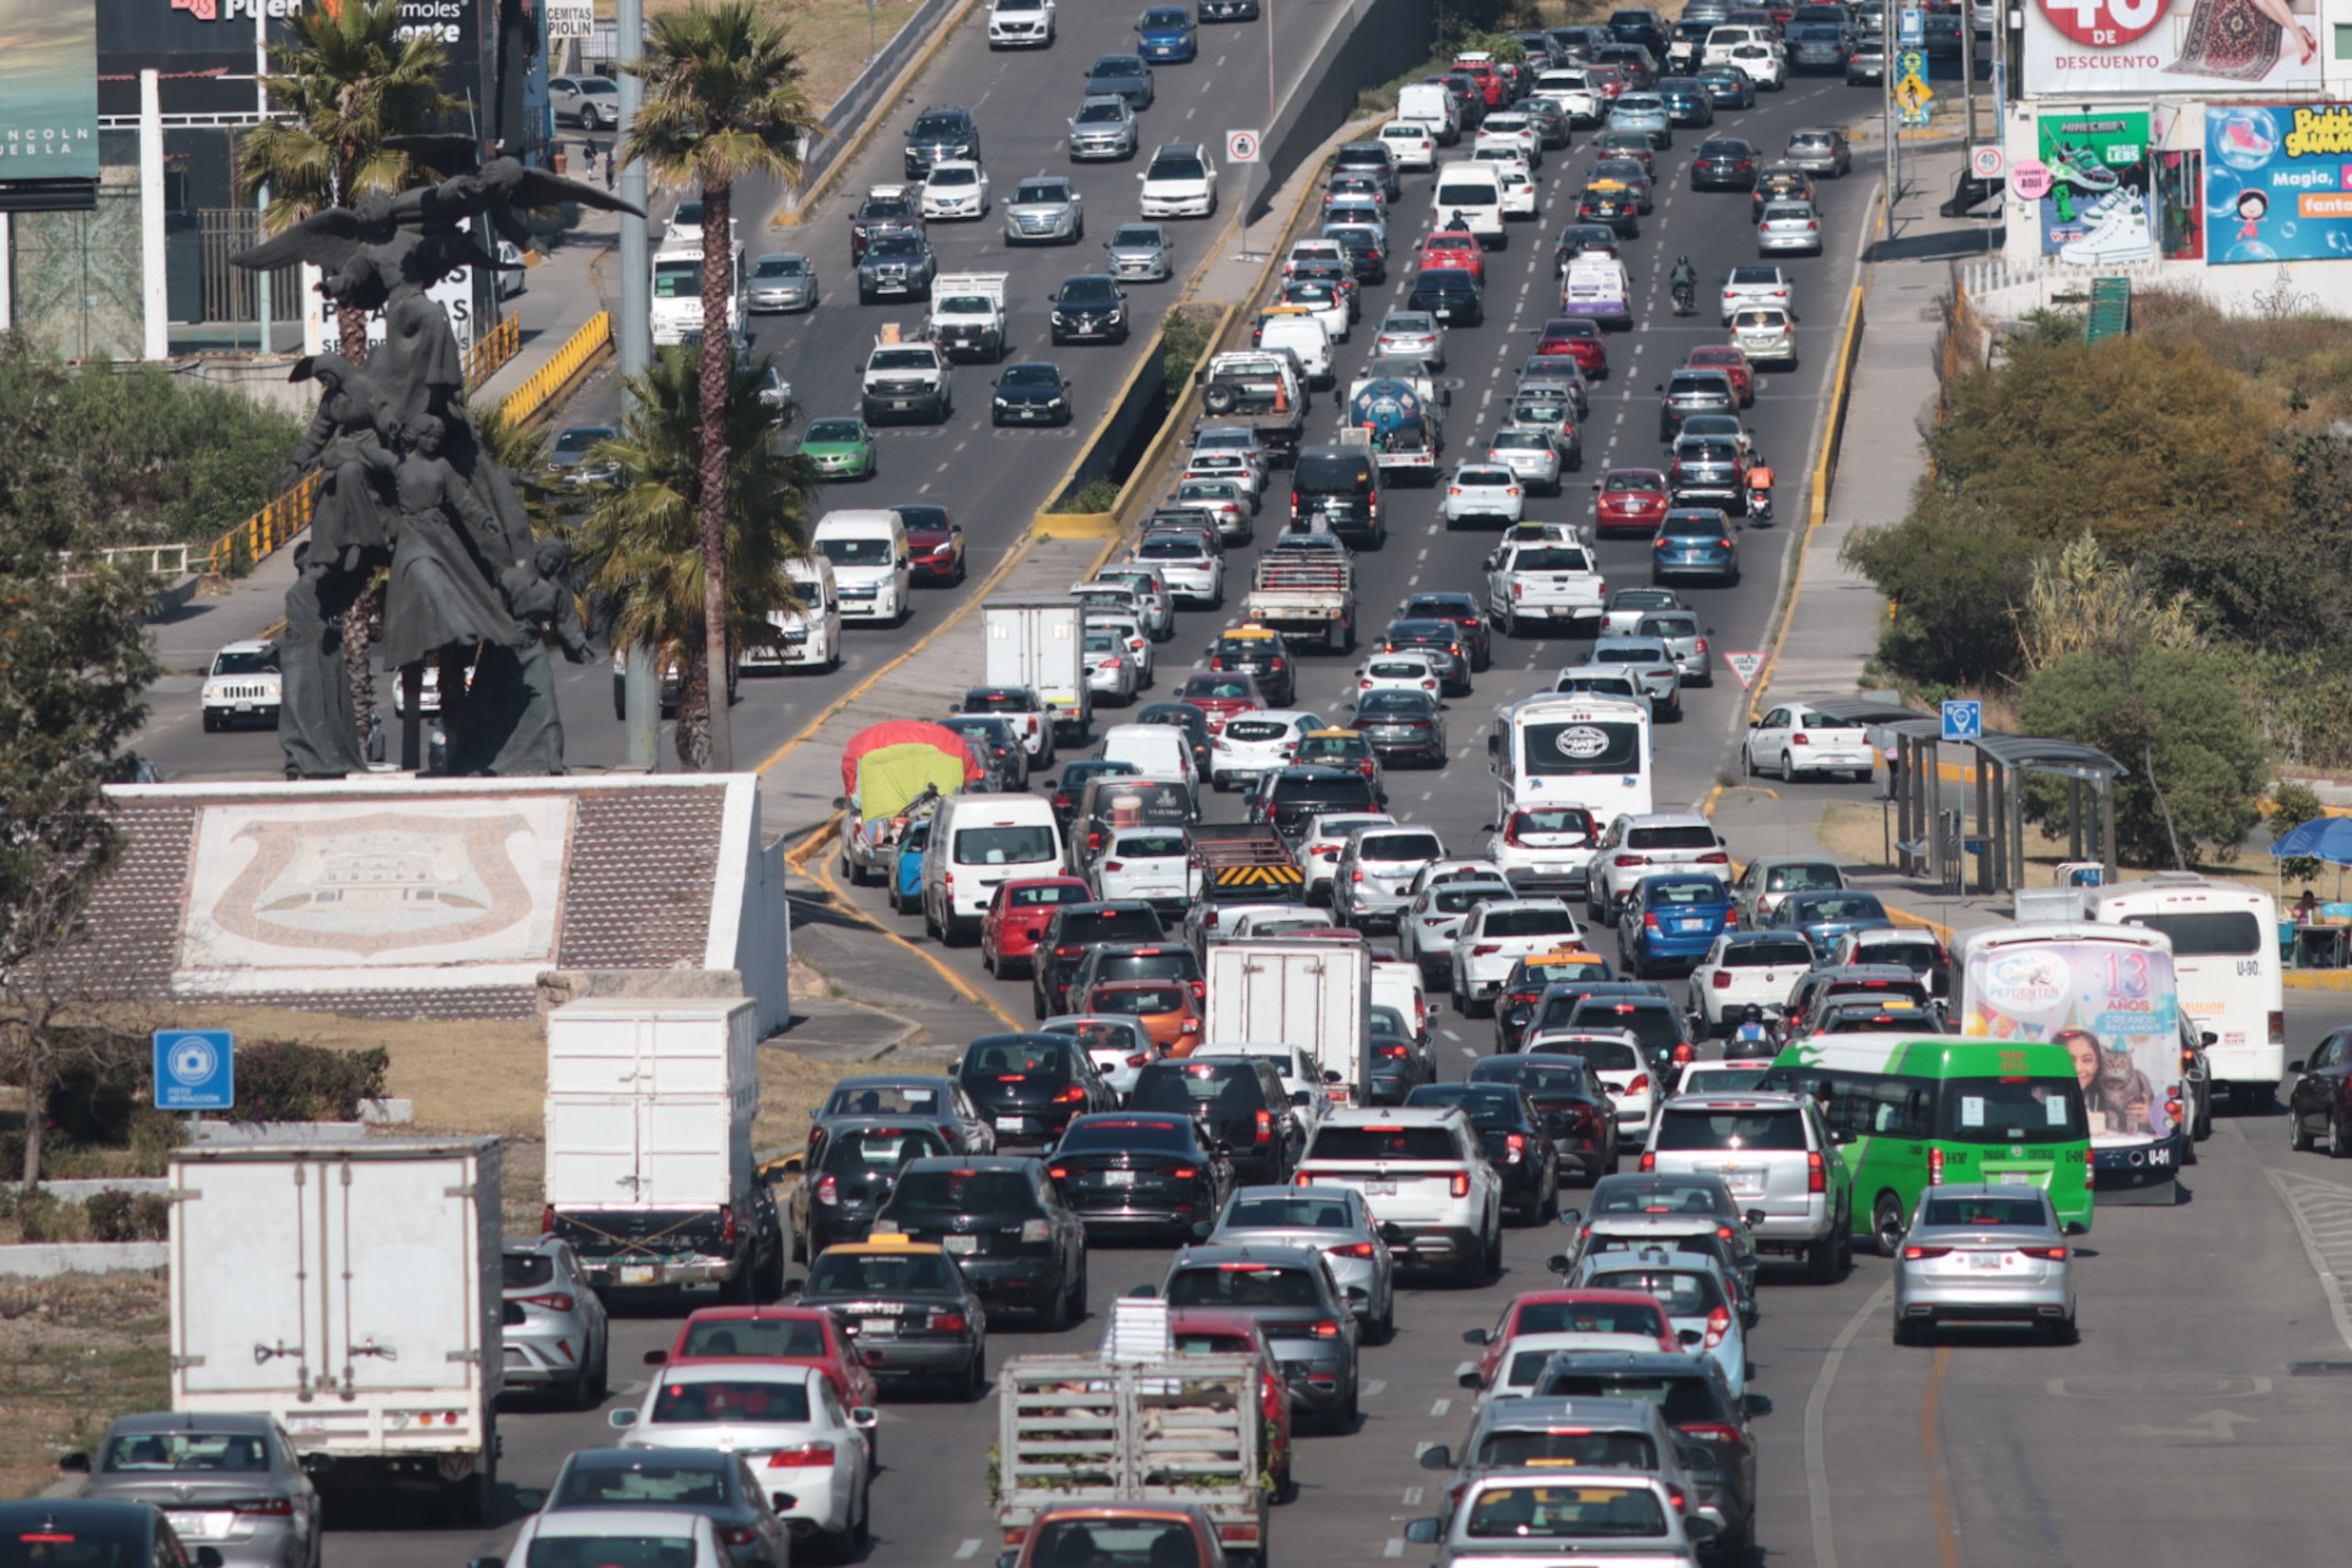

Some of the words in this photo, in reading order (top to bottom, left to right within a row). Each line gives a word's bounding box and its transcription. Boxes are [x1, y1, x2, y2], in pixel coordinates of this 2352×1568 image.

[547, 7, 591, 21] CEMITAS
[548, 21, 591, 35] PIOLIN
[2093, 30, 2116, 44] DE
[2055, 55, 2159, 70] DESCUENTO
[1980, 154, 1994, 165] 40
[2273, 169, 2334, 188] Magia,
[2104, 952, 2151, 997] 13
[2237, 960, 2258, 976] U-90
[2107, 996, 2150, 1011] AÑOS
[2148, 1149, 2170, 1164] U-01
